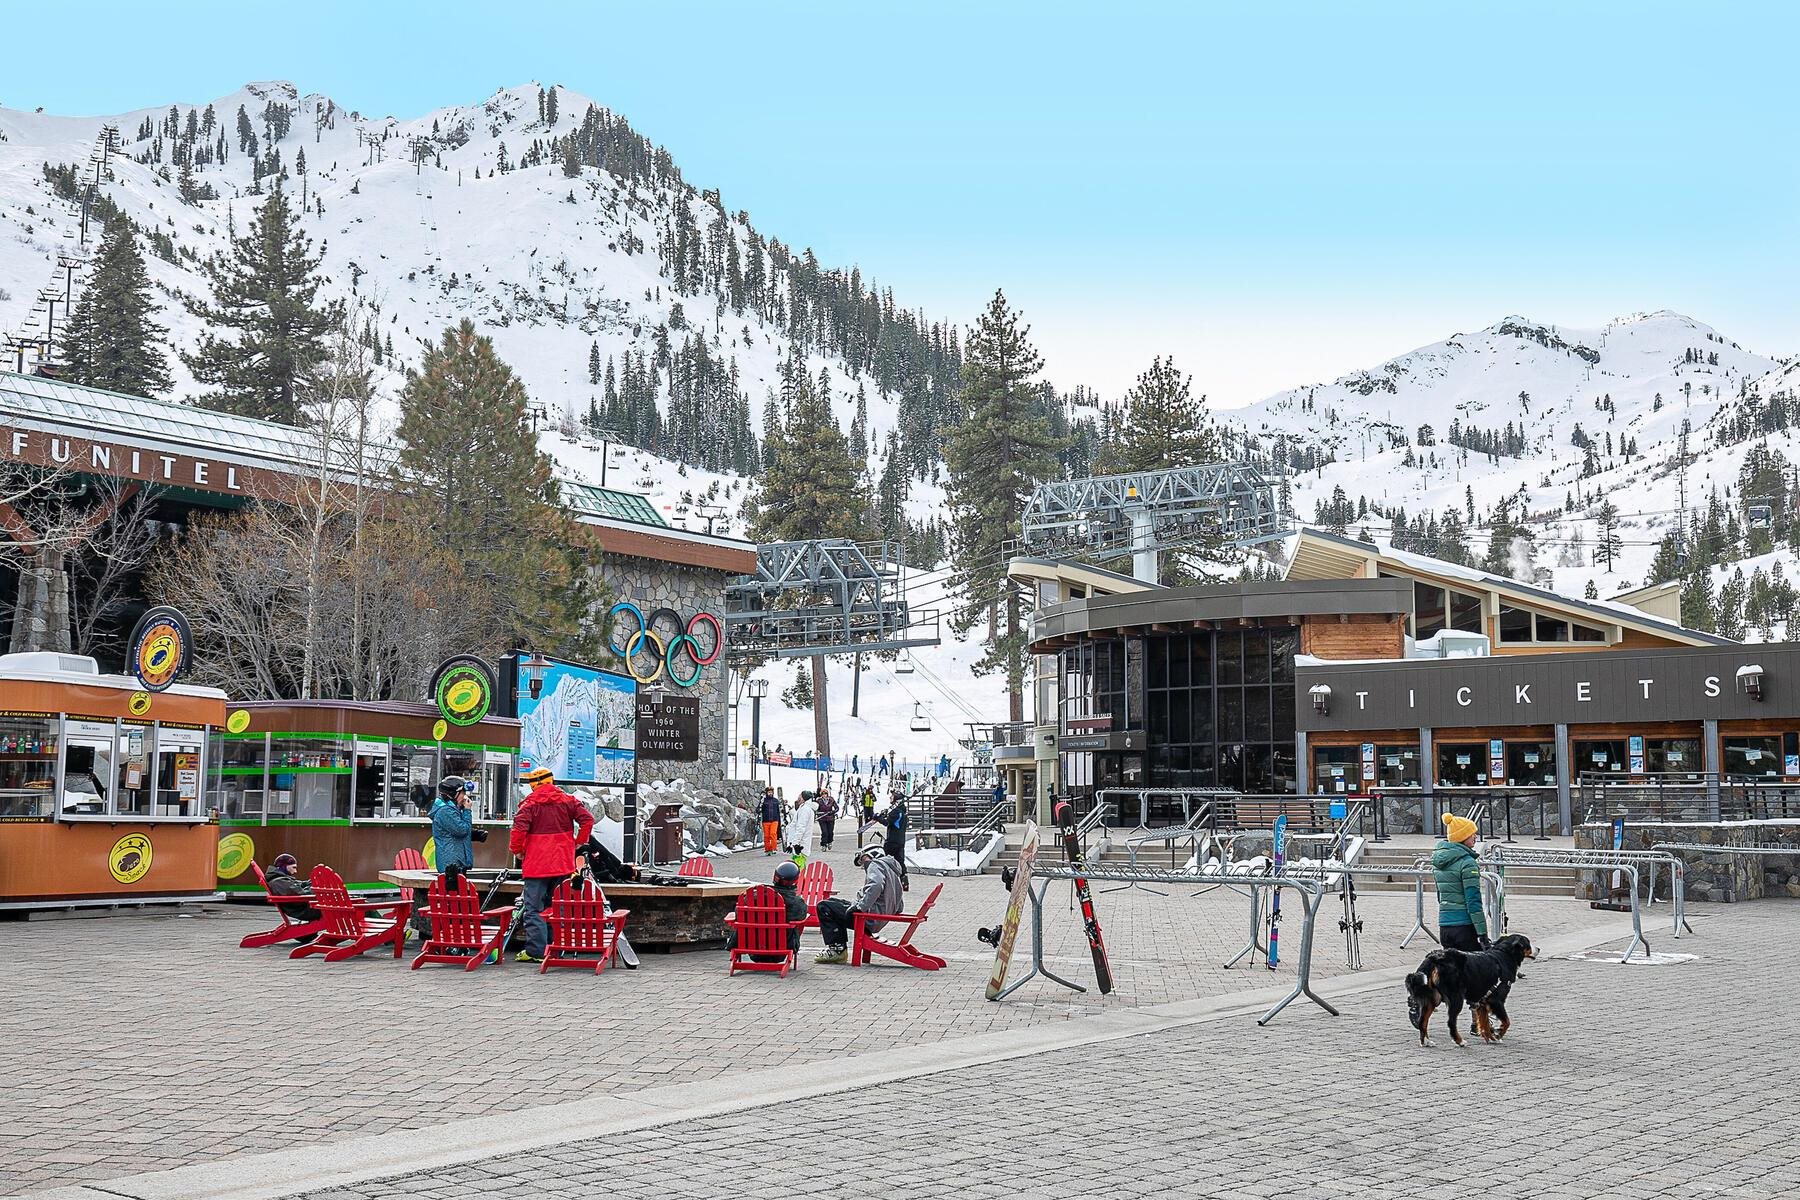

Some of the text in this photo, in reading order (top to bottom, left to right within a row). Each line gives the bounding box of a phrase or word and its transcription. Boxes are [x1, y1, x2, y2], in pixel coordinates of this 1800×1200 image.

[12, 432, 241, 490] FUNITEL
[1355, 676, 1721, 710] TICKETS
[638, 703, 695, 715] HO OF THE
[655, 718, 674, 727] 1960
[648, 728, 680, 738] WINTER
[642, 741, 684, 750] OLYMPICS
